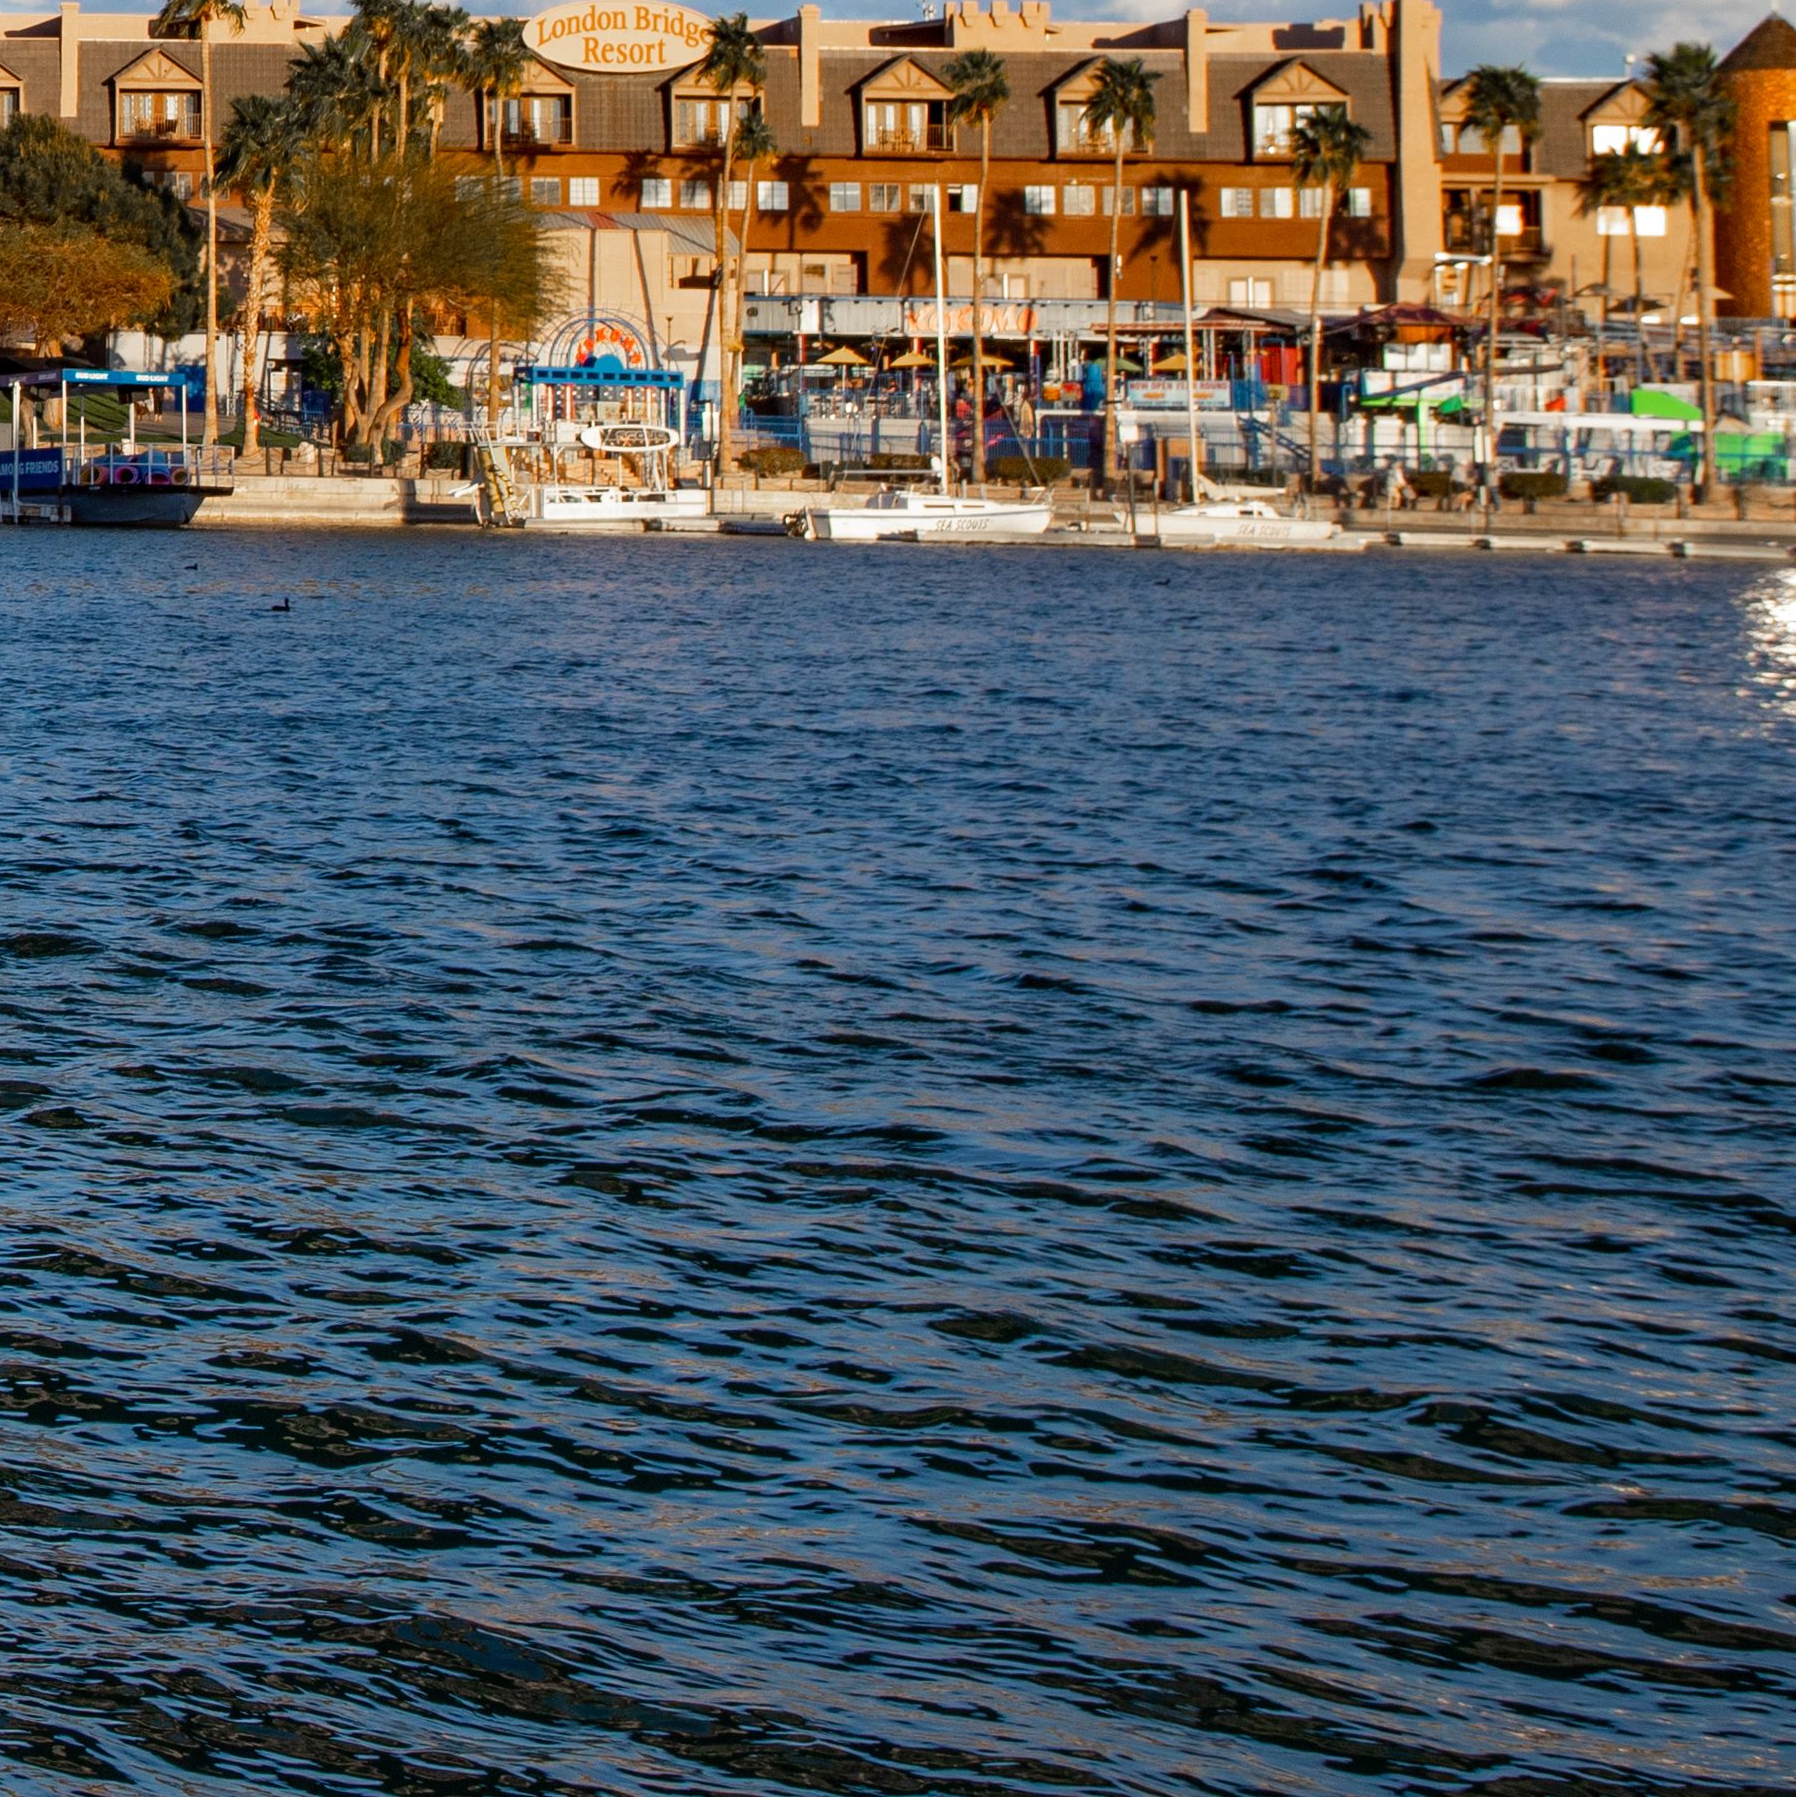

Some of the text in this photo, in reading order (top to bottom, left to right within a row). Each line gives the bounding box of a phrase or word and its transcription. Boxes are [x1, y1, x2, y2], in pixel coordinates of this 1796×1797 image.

[537, 5, 713, 48] London Bridge
[582, 36, 666, 64] Resort
[25, 460, 59, 475] FRIENDS
[935, 518, 990, 532] SEA SCOUTS
